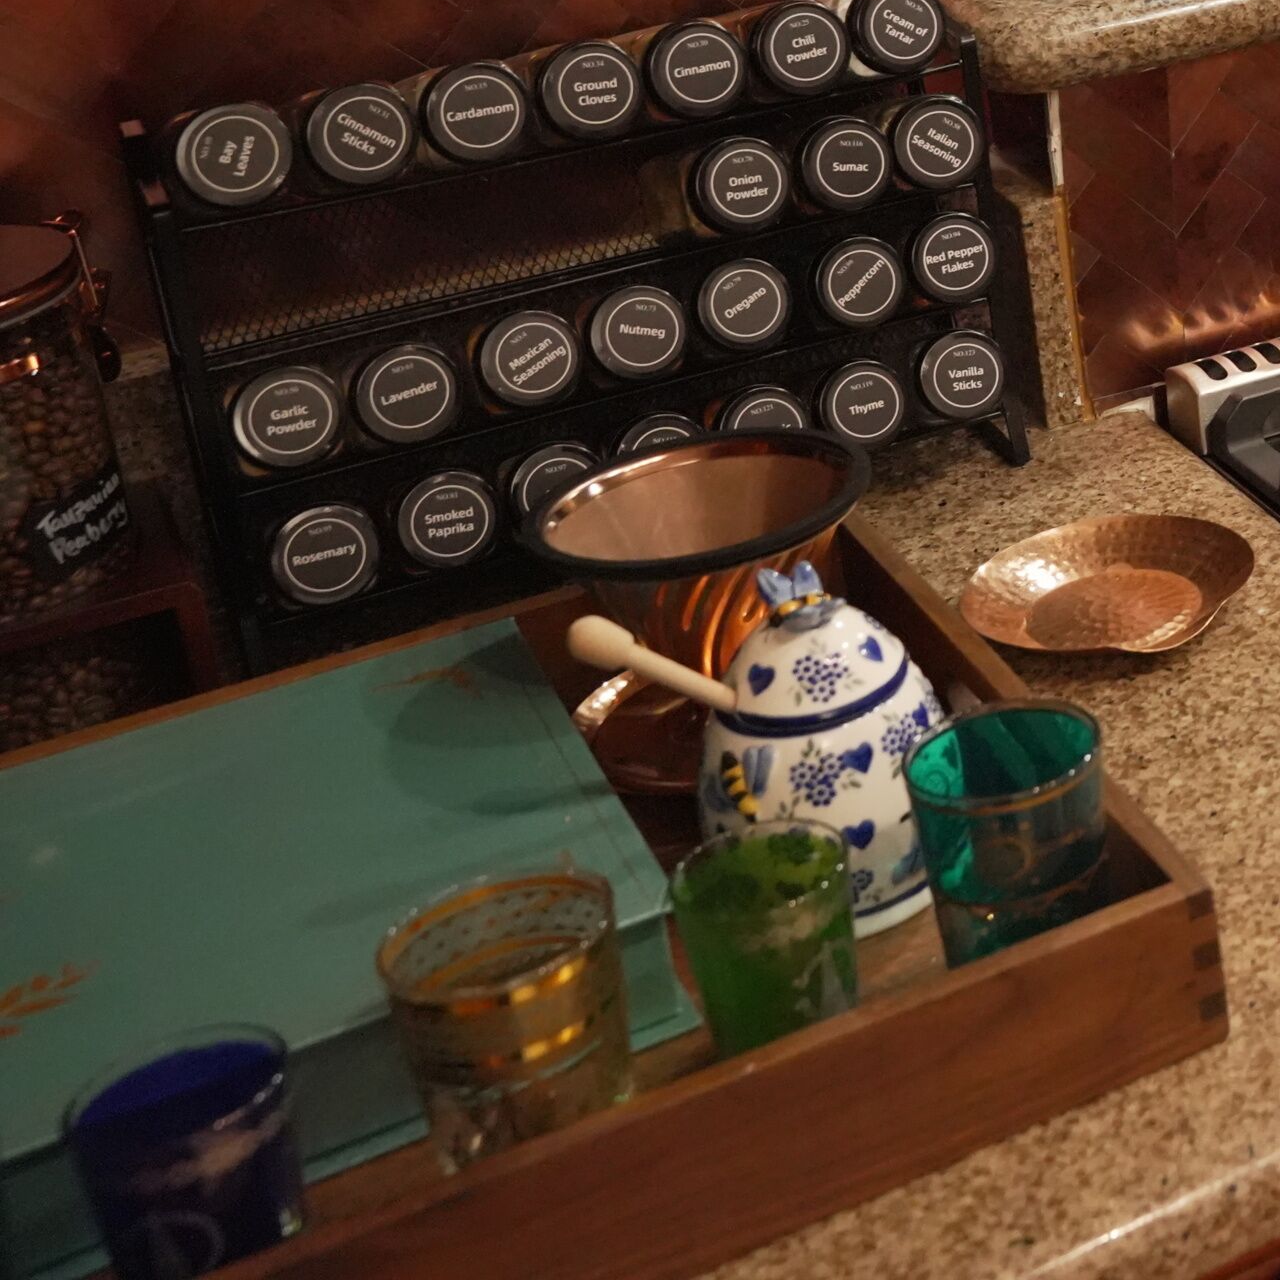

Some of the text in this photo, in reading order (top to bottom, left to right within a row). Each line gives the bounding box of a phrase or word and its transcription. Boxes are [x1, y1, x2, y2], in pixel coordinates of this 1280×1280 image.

[882, 9, 929, 37] Cream of
[792, 33, 816, 48] Chili
[885, 24, 916, 45] Tartar
[786, 46, 828, 64] Powder
[674, 59, 731, 78] Cinnamon
[573, 77, 618, 93] Ground
[578, 93, 617, 106] Cloves
[446, 103, 515, 123] Cardamom
[337, 113, 397, 148] Cinnamon
[927, 127, 959, 151] Italian
[218, 140, 238, 164] Bay
[341, 132, 376, 156] Sticks
[911, 134, 962, 168] Seasoning
[232, 135, 256, 177] Leaves
[832, 162, 869, 172] Sumac
[728, 174, 762, 188] Onion
[726, 186, 769, 202] Powder
[926, 243, 984, 265] Red Pepper
[941, 260, 975, 275] Flakes
[837, 259, 885, 308] Peppercorn
[724, 287, 767, 319] Oregano
[619, 324, 666, 339] Nutmeg
[508, 337, 553, 371] Mexican
[513, 345, 567, 386] Seasoning
[948, 366, 984, 379] Vanilla
[381, 381, 439, 406] Lavender
[953, 379, 983, 392] Sticks
[270, 404, 309, 420] Garlic
[849, 399, 885, 416] Thyme
[266, 418, 318, 436] Powder
[425, 506, 475, 525] Smoked
[428, 522, 475, 539] Paprika
[292, 543, 357, 567] Rosemary
